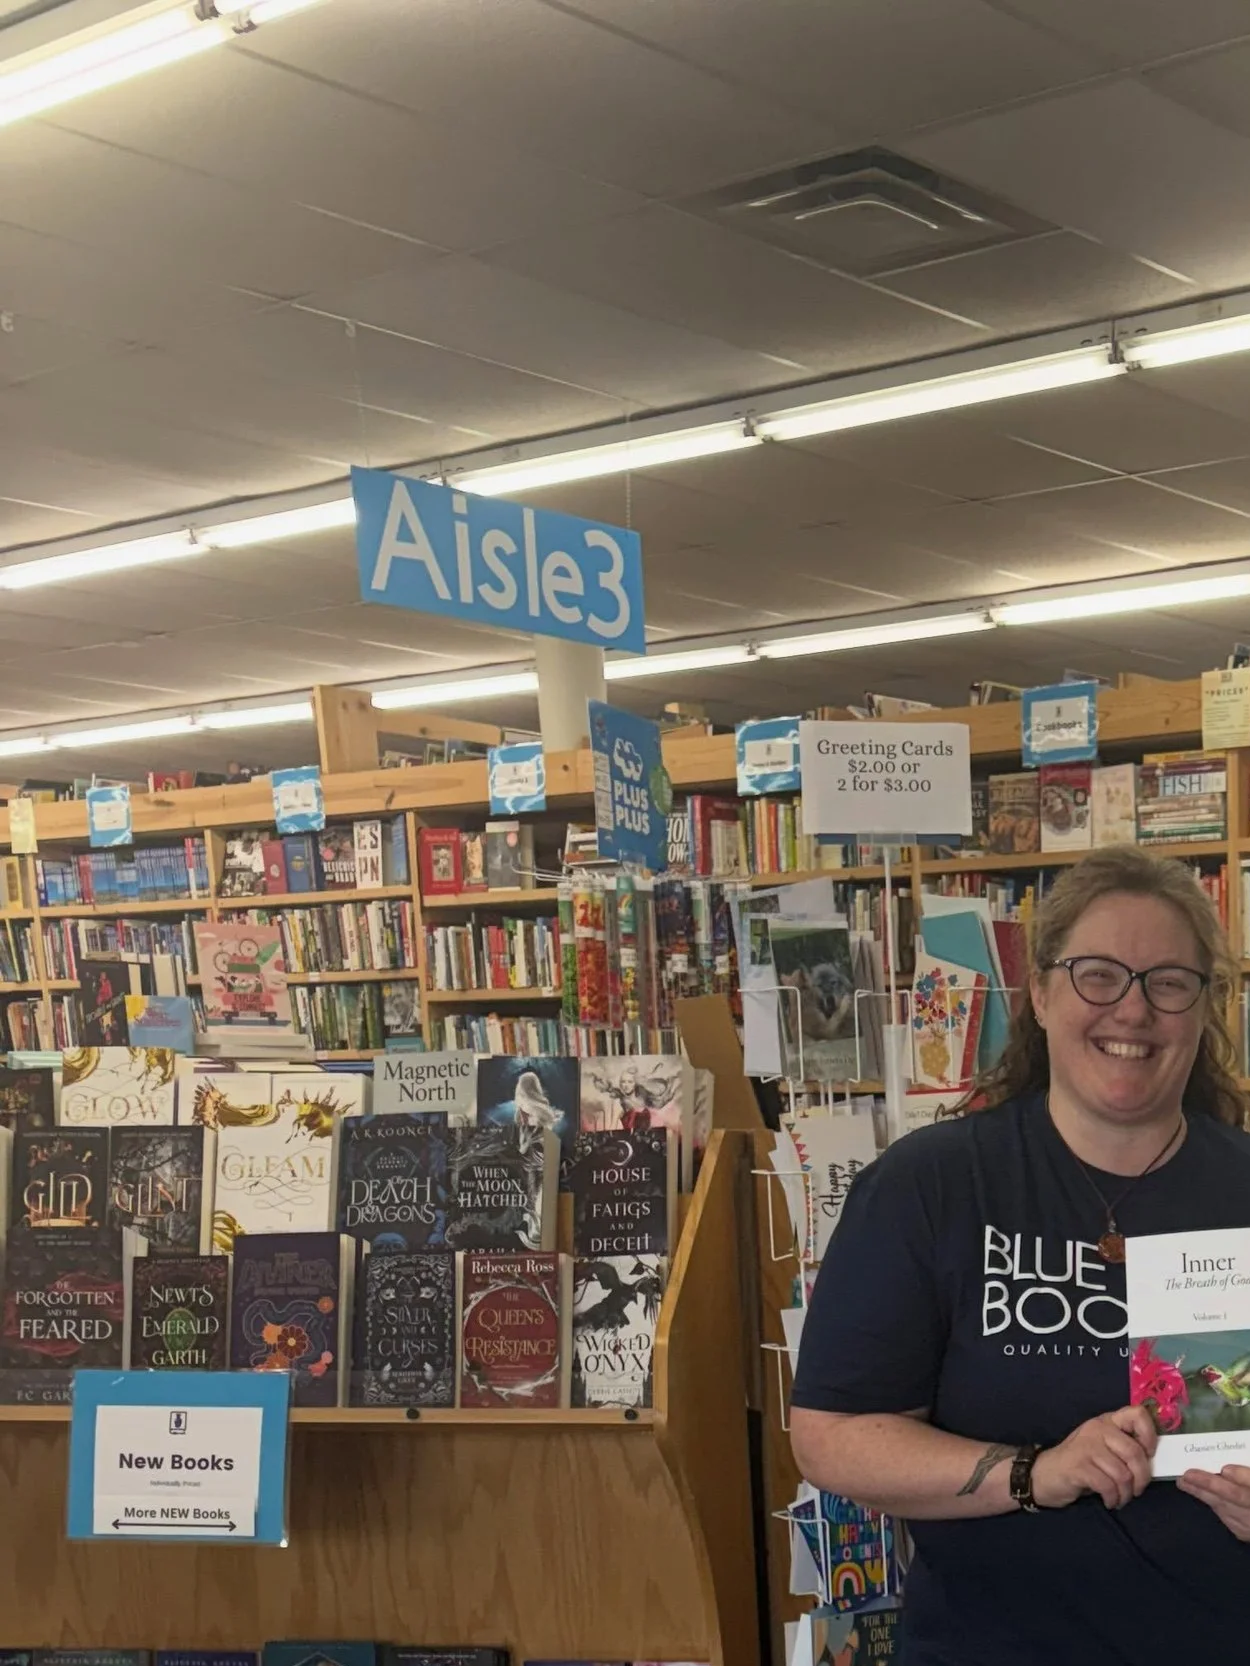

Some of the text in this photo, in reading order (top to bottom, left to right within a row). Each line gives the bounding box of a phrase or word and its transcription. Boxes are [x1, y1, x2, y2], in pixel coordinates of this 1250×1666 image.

[817, 740, 953, 758] Greeting Cards
[848, 760, 921, 774] $2.00 or
[837, 776, 931, 793] 2 for $3.00
[1162, 776, 1203, 795] FISH
[613, 779, 649, 817] PLUS
[615, 804, 650, 836] PLUS
[384, 1060, 470, 1083] Magnetic
[398, 1082, 456, 1103] North
[66, 1092, 167, 1122] GLOW
[221, 1153, 325, 1182] GLEAM
[473, 1166, 509, 1179] WHEN
[592, 1167, 651, 1185] HOUSE
[351, 1177, 432, 1206] DEATH
[476, 1179, 524, 1194] MOON
[614, 1189, 627, 1197] OF
[458, 1192, 528, 1209] HATCHED
[346, 1203, 436, 1227] DRAGONS
[610, 1223, 634, 1231] AND
[591, 1232, 652, 1252] DECEIT
[471, 1259, 554, 1275] Rebecca Ross
[984, 1225, 1106, 1291] BLUE
[1181, 1253, 1236, 1273] Inner
[1165, 1278, 1182, 1290] The
[1185, 1274, 1217, 1289] Breath
[1219, 1273, 1228, 1291] of
[16, 1291, 115, 1308] FORGOTTEN
[140, 1315, 220, 1338] EMERALD
[1192, 1313, 1221, 1322] Volume
[19, 1319, 113, 1344] FEARED
[466, 1337, 556, 1364] RESISTANCE
[576, 1334, 651, 1352] WICKED
[1003, 1344, 1101, 1357] QUALITY
[152, 1350, 207, 1365] GARTH
[584, 1353, 645, 1374] ONYX
[119, 1453, 234, 1471] New Books
[124, 1507, 231, 1520] More NEW Books
[870, 1628, 890, 1642] ONE
[874, 1640, 895, 1655] LOVE
